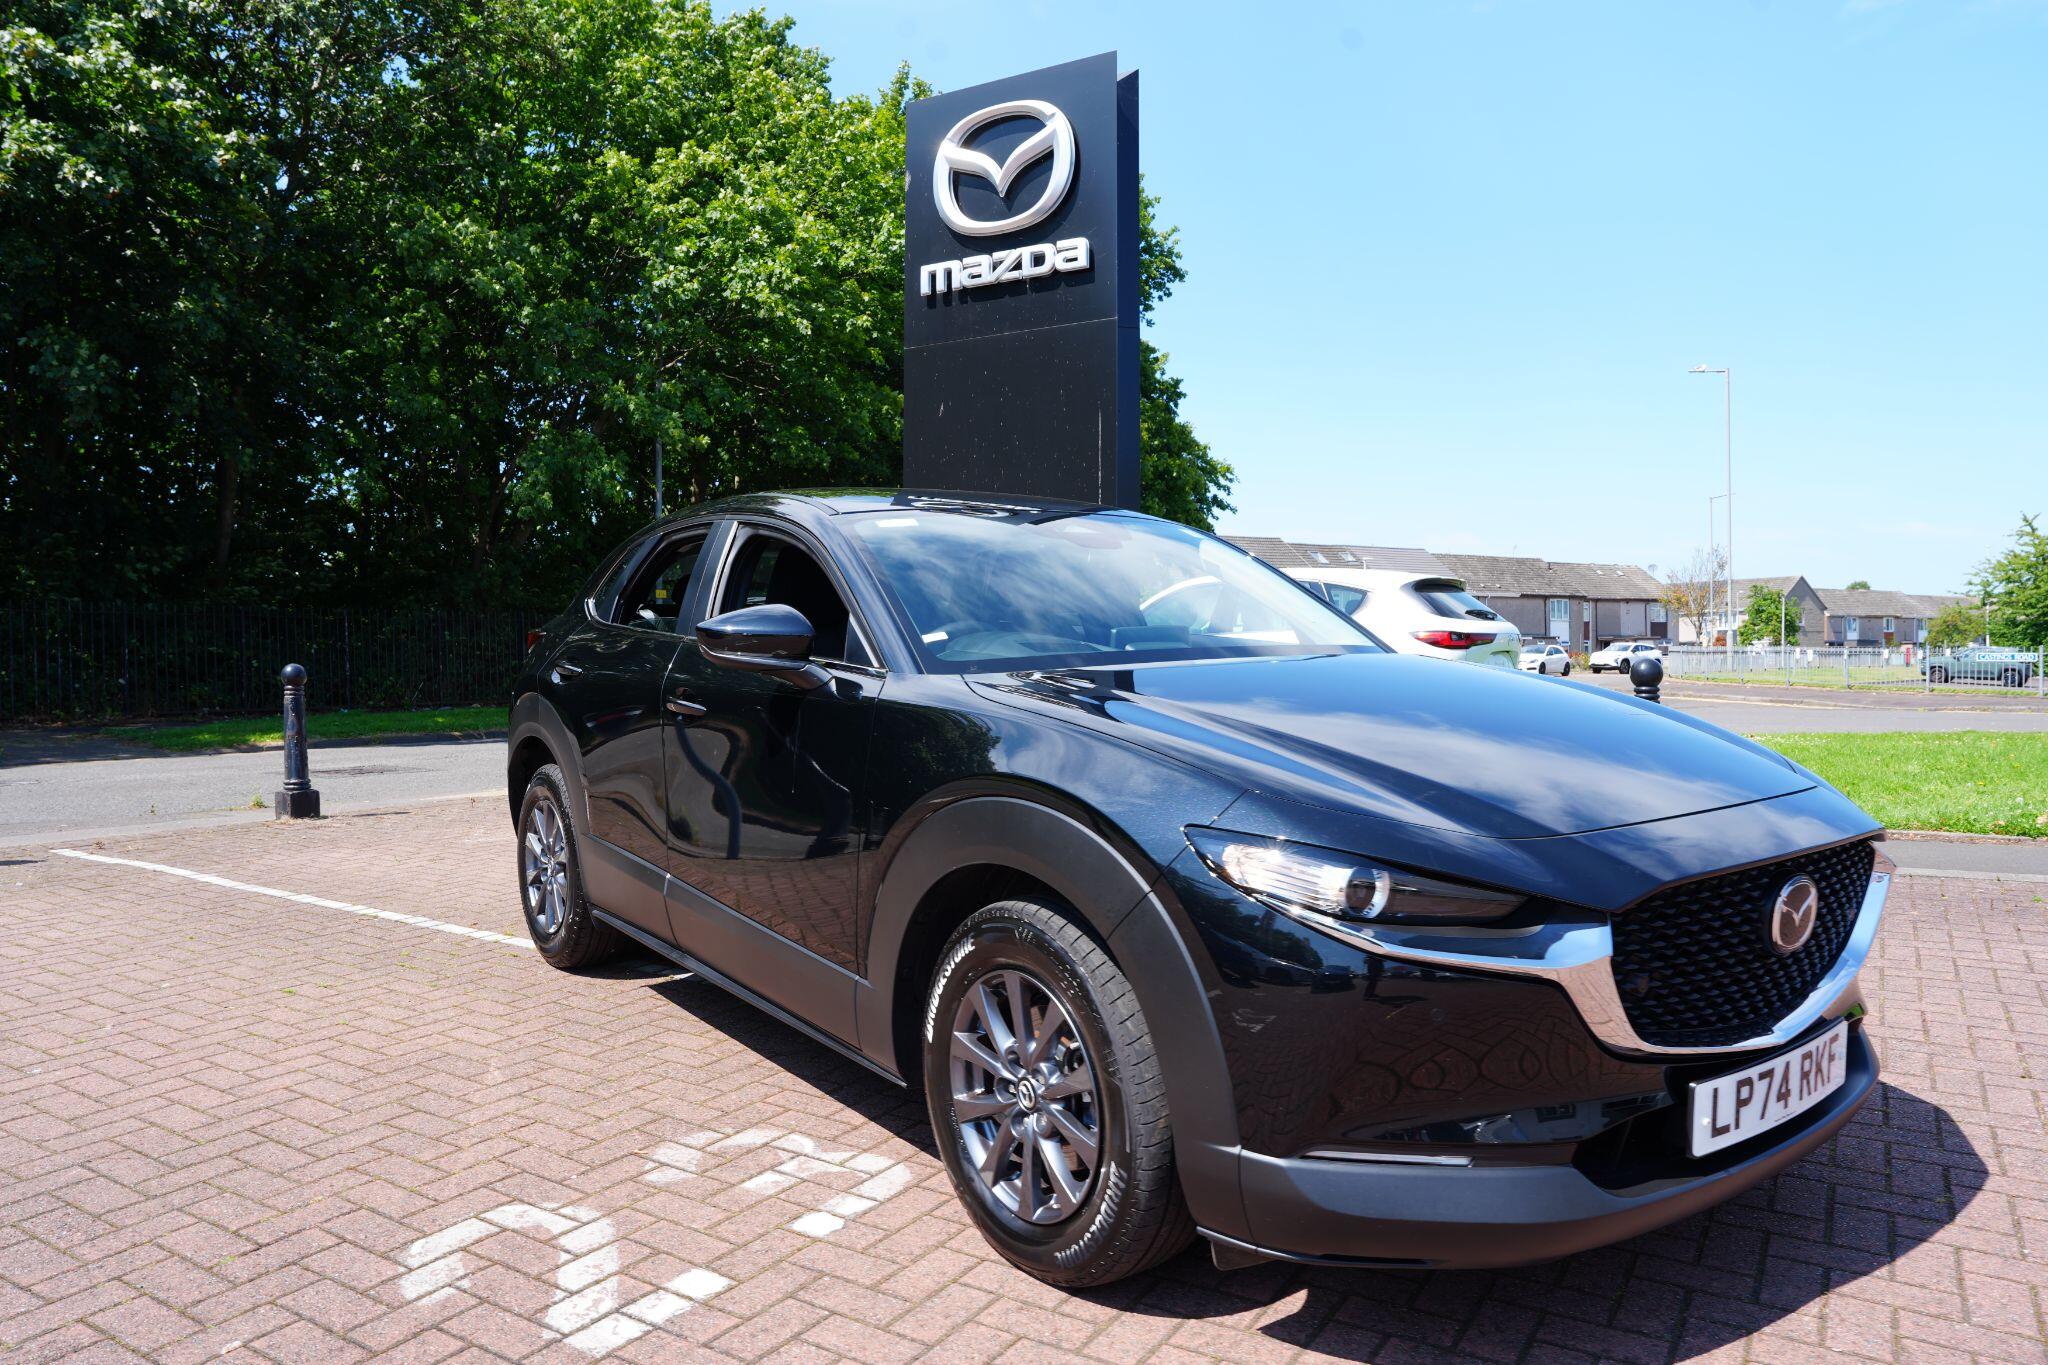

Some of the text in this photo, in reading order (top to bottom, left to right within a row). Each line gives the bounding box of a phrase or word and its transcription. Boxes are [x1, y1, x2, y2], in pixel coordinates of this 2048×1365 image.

[925, 932, 976, 1044] BRIDGESTONE
[1711, 1033, 1840, 1139] LP74 RKF
[399, 1127, 911, 1358] 23
[1054, 1160, 1128, 1269] BRIDGESTONE
